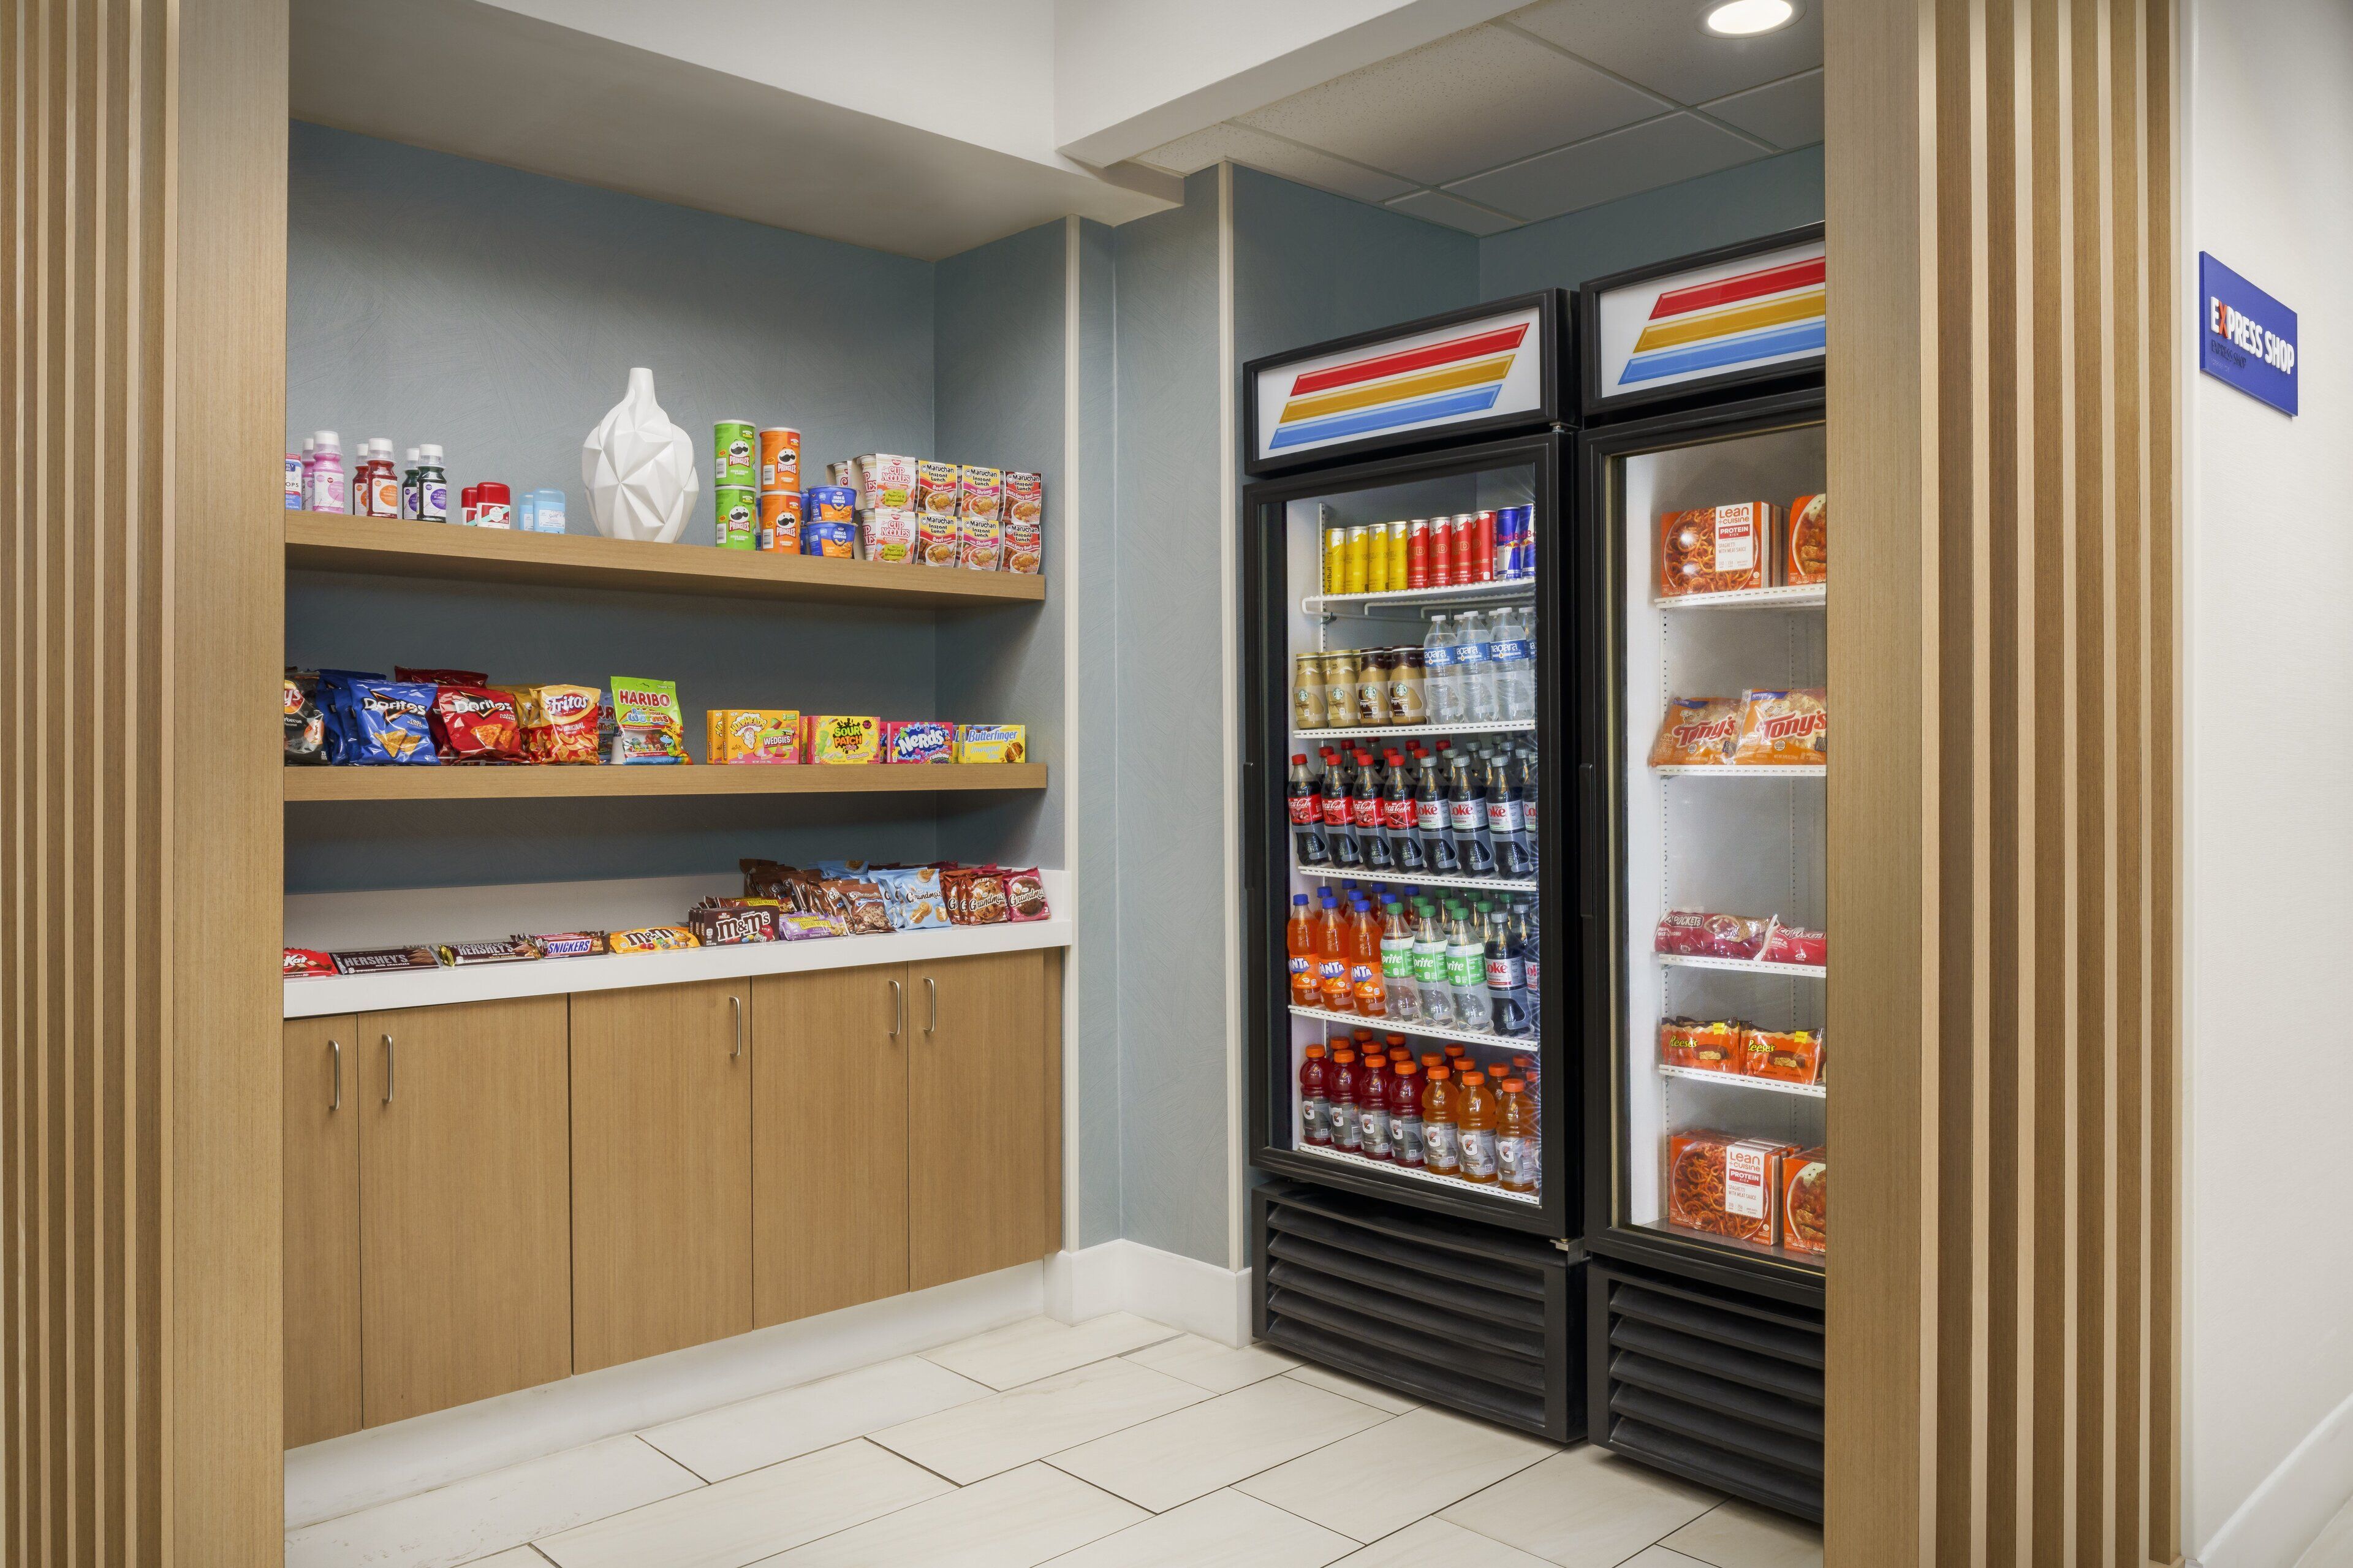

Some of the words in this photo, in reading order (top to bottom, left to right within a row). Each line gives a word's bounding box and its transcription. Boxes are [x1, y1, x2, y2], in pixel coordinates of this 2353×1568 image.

[2211, 297, 2262, 358] EXPRESS
[2265, 331, 2295, 374] SHOP
[2211, 339, 2233, 363] EXPRESS
[2233, 352, 2247, 369] SHOP
[729, 456, 749, 467] PRINGLES
[778, 463, 797, 474] PRINGLES
[889, 466, 905, 475] CUP
[927, 464, 954, 473] Maruchan
[971, 469, 997, 477] Maruchan
[881, 472, 911, 484] NOODLES
[1719, 506, 1749, 519] Lean
[729, 521, 749, 532] PRINGLES
[888, 520, 904, 530] CUP
[776, 528, 795, 539] PRINGLES
[881, 528, 910, 538] NOODLES
[545, 695, 588, 715] Fritos
[620, 690, 670, 707] HARIBO
[363, 697, 426, 716] Doritos
[454, 699, 513, 713] Doritos
[564, 722, 585, 732] ORIGINAL
[729, 716, 767, 733] WARHEADS
[1756, 710, 1826, 738] Tony's
[835, 725, 861, 737] SOUR
[968, 729, 1018, 742] Butterfinger
[1673, 716, 1736, 746] Tony's
[763, 736, 790, 745] WEDGIES
[834, 735, 862, 748] PATCH
[906, 890, 942, 903] Grandma's
[969, 892, 1005, 911] Grandma's
[1674, 915, 1702, 926] POCKETS
[548, 941, 590, 953] SNICKERS
[344, 954, 408, 967] HERSHEY'S
[1670, 1035, 1698, 1048] Reese's
[1748, 1039, 1776, 1052] Reese's
[1303, 1100, 1315, 1120] G
[1332, 1107, 1344, 1127] G
[1361, 1114, 1375, 1134] G
[1390, 1119, 1403, 1140] G
[1427, 1126, 1441, 1147] G
[1461, 1134, 1478, 1156] G
[1499, 1141, 1515, 1162] G
[1730, 1152, 1760, 1165] Lean
[1730, 1170, 1759, 1181] PROTEIN
